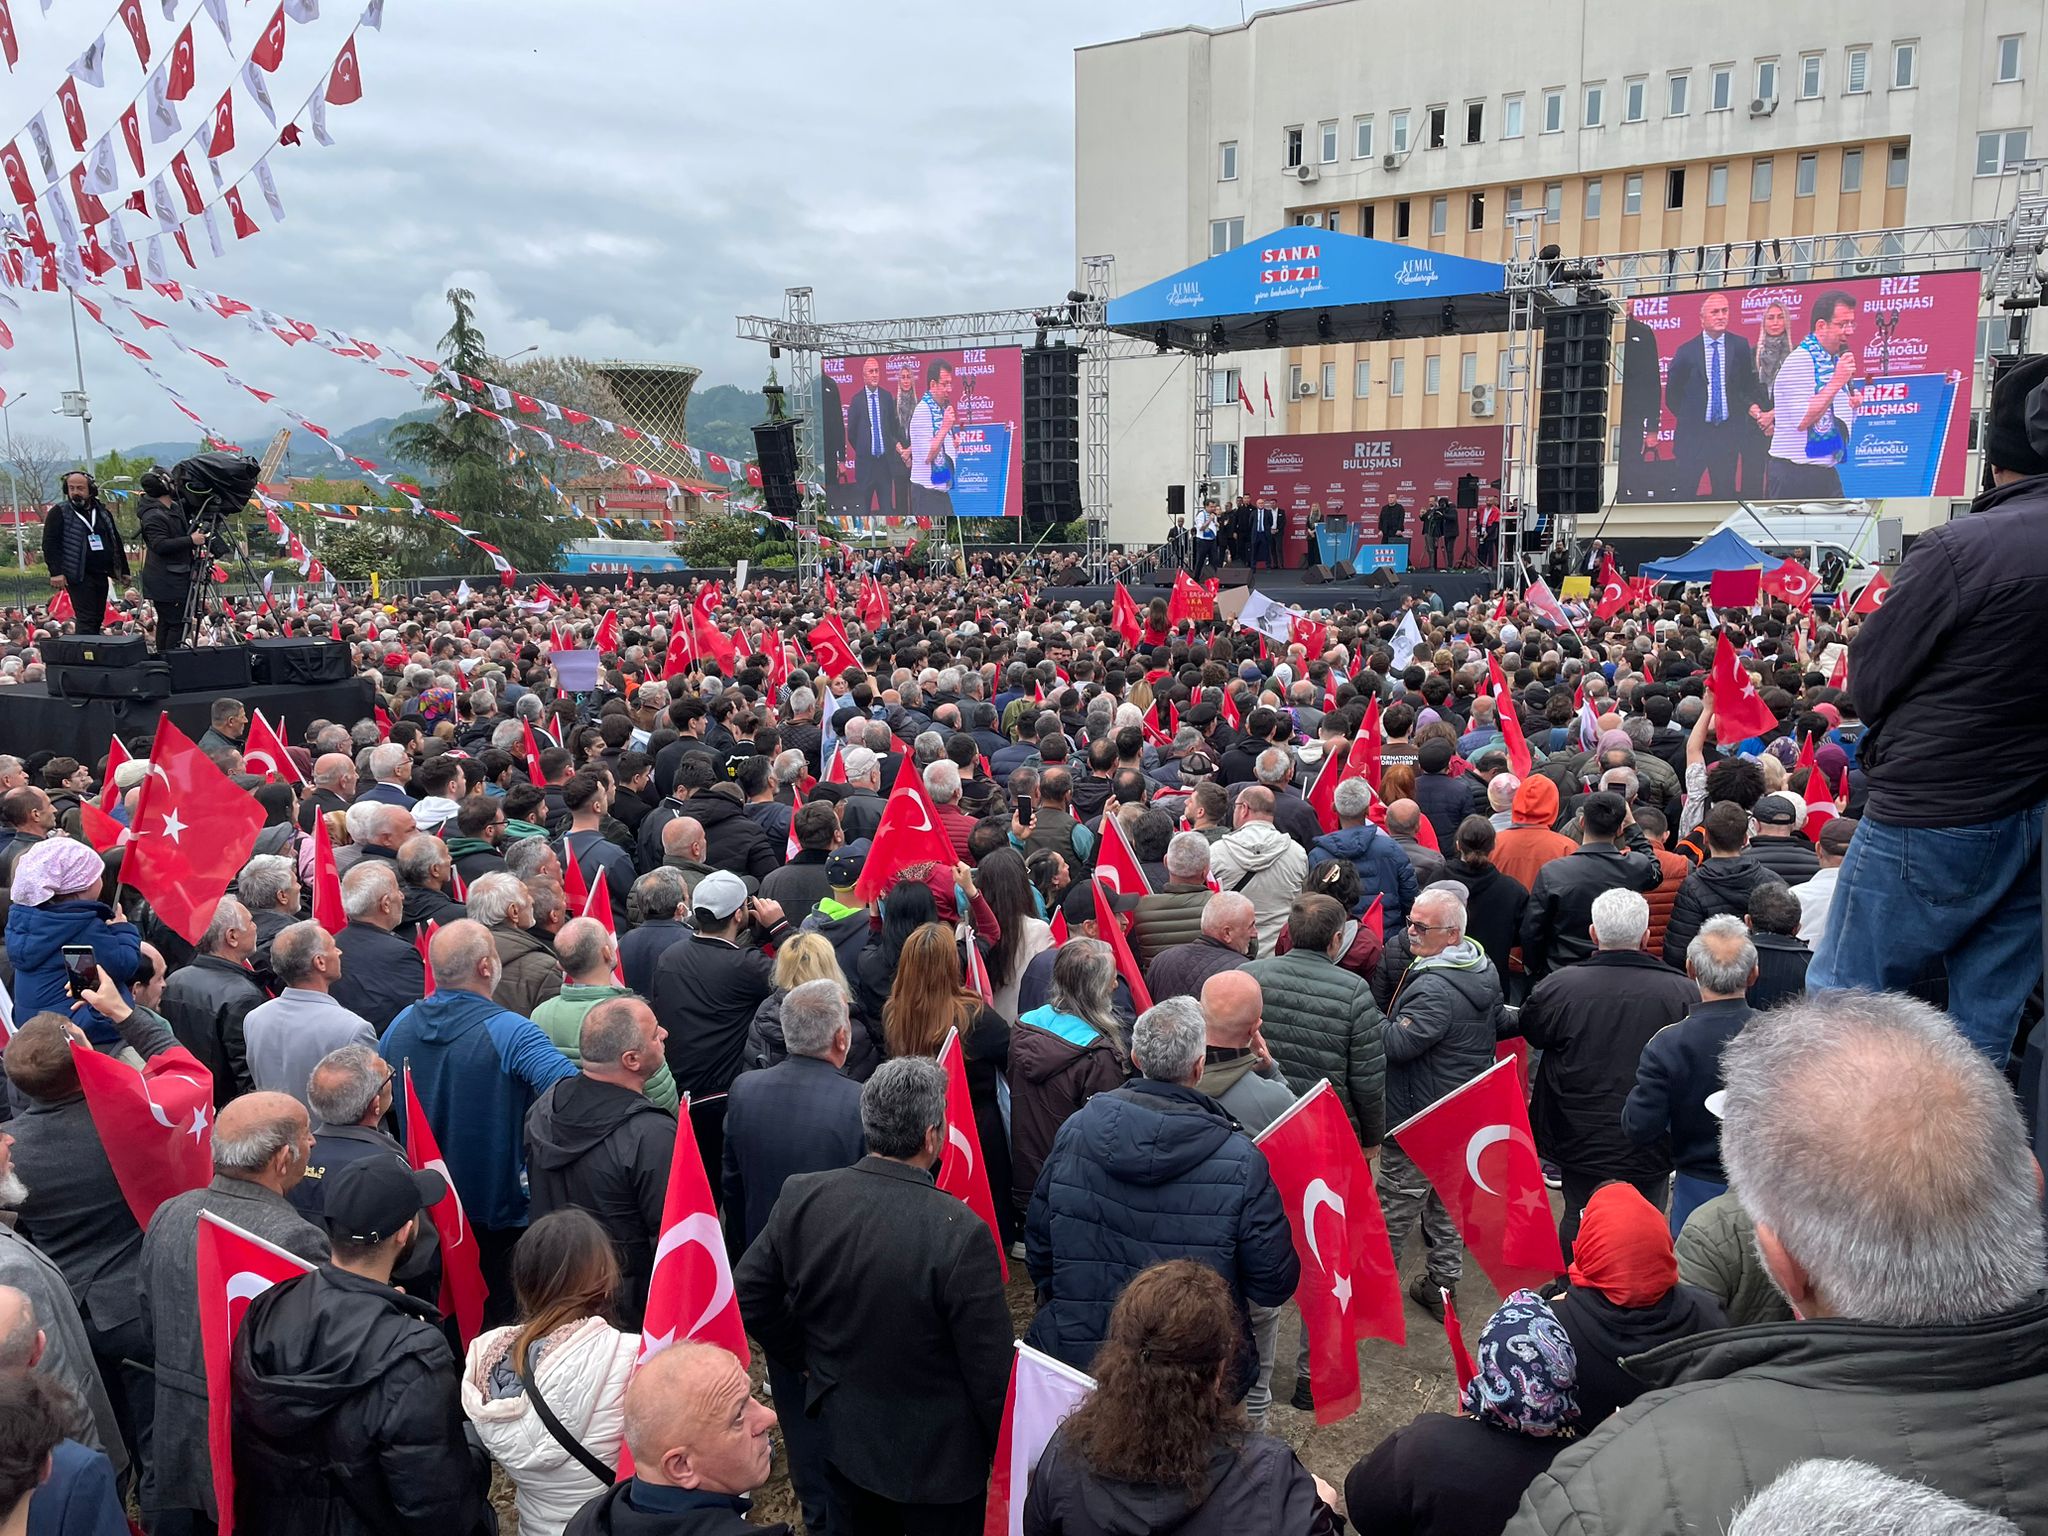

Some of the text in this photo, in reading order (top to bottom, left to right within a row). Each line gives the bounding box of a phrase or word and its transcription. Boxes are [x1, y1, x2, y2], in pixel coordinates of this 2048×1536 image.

[1264, 245, 1316, 263] SANA
[1403, 258, 1432, 272] KEMAL
[1264, 265, 1316, 284] SÖZ!
[1863, 296, 1934, 313] BULUŞMASI
[1856, 402, 1918, 418] ULUŞMASI
[1444, 450, 1485, 458] İMAMOĞLU
[1855, 445, 1908, 456] İMAMOĞLU
[1343, 457, 1402, 471] BULUŞMASI
[590, 562, 628, 574] SANA
